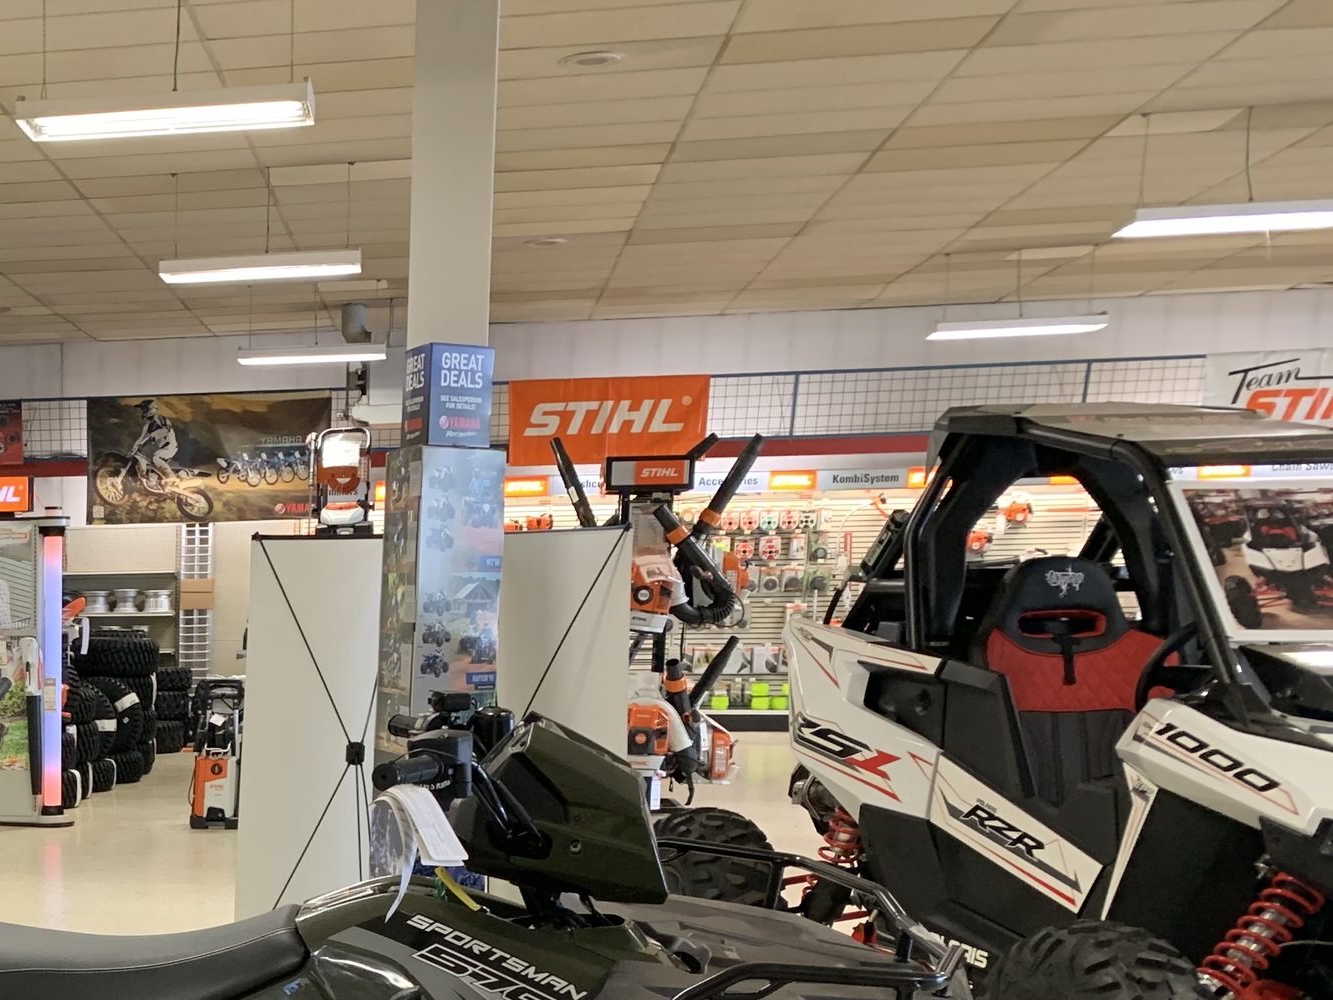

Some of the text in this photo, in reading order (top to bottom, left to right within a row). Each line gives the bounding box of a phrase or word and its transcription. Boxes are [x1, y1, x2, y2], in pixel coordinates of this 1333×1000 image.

[406, 353, 425, 374] GREAT
[441, 352, 485, 371] GREAT
[405, 371, 425, 392] DEALS
[440, 370, 483, 389] DEALS
[1228, 358, 1321, 404] Team
[450, 395, 482, 403] SALESPERSON
[1247, 388, 1333, 421] STI
[449, 416, 481, 430] YAMAHA
[523, 398, 684, 437] STIHL
[260, 435, 302, 446] YAMAHA
[641, 467, 679, 478] STIHL
[699, 476, 758, 487] Acceies
[832, 473, 899, 484] KombiSystem
[285, 503, 311, 513] YAMA
[1154, 723, 1281, 792] 1000
[960, 804, 1045, 862] RZR
[406, 914, 587, 1000] SPORTSMAN
